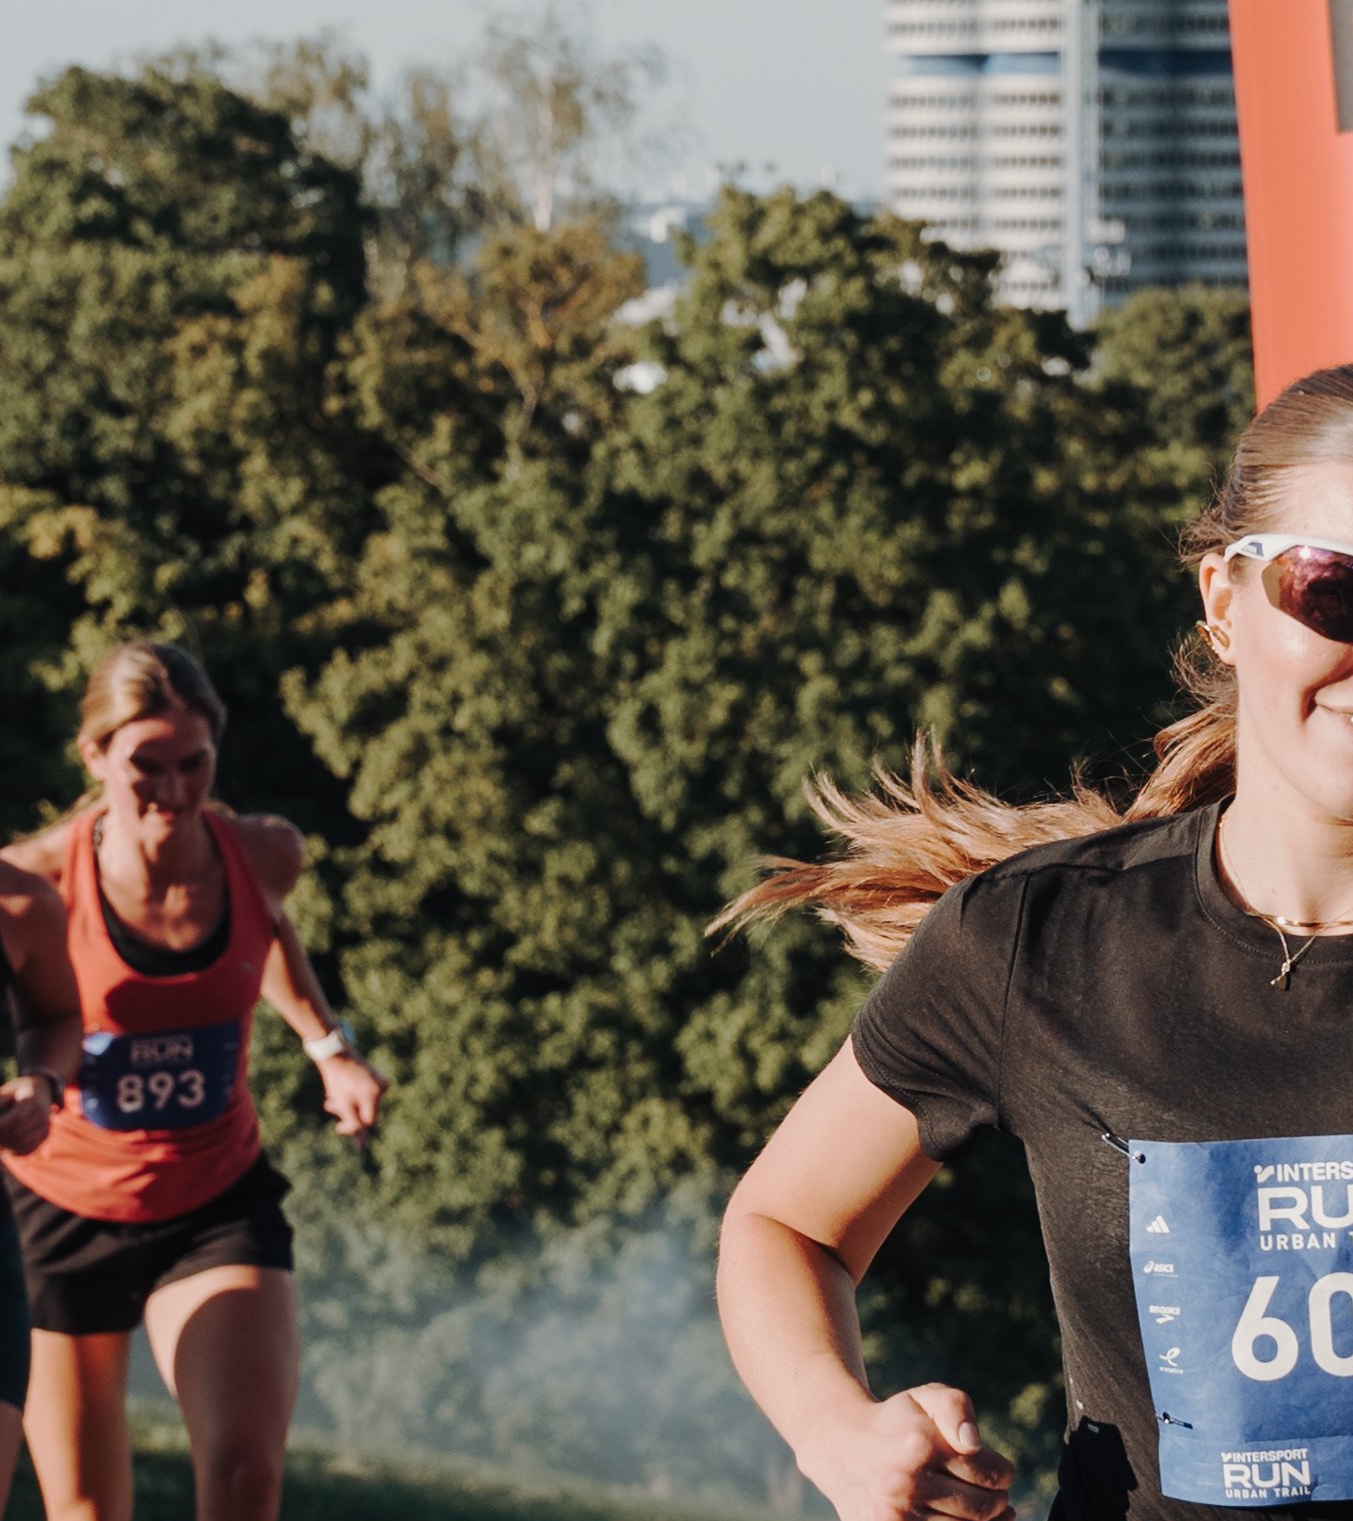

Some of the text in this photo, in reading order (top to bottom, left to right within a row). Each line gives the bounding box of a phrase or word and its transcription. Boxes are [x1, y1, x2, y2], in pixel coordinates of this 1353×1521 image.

[117, 1069, 206, 1113] 893
[1260, 1232, 1336, 1251] URBAN
[1233, 1448, 1308, 1463] INTERSPORT
[1223, 1461, 1311, 1488] RUN
[1225, 1486, 1311, 1499] URBAN TRAIL
